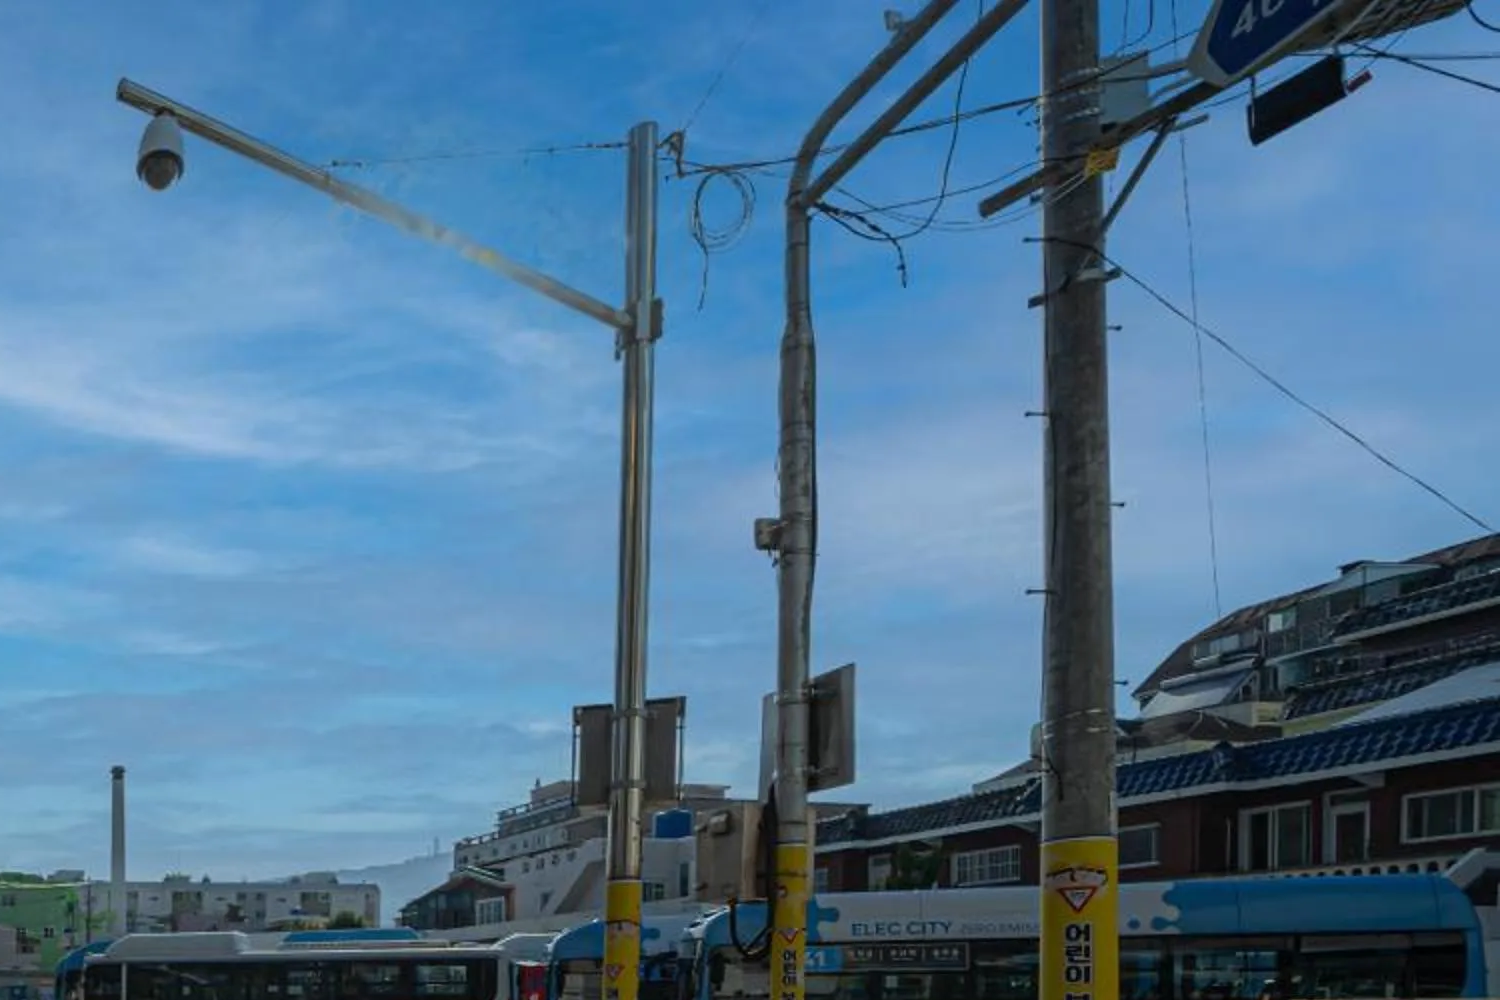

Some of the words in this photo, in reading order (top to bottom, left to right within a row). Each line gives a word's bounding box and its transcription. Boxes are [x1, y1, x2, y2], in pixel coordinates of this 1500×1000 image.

[851, 922, 901, 937] ELEC
[905, 920, 953, 936] CITY
[1064, 921, 1092, 985] 어린이
